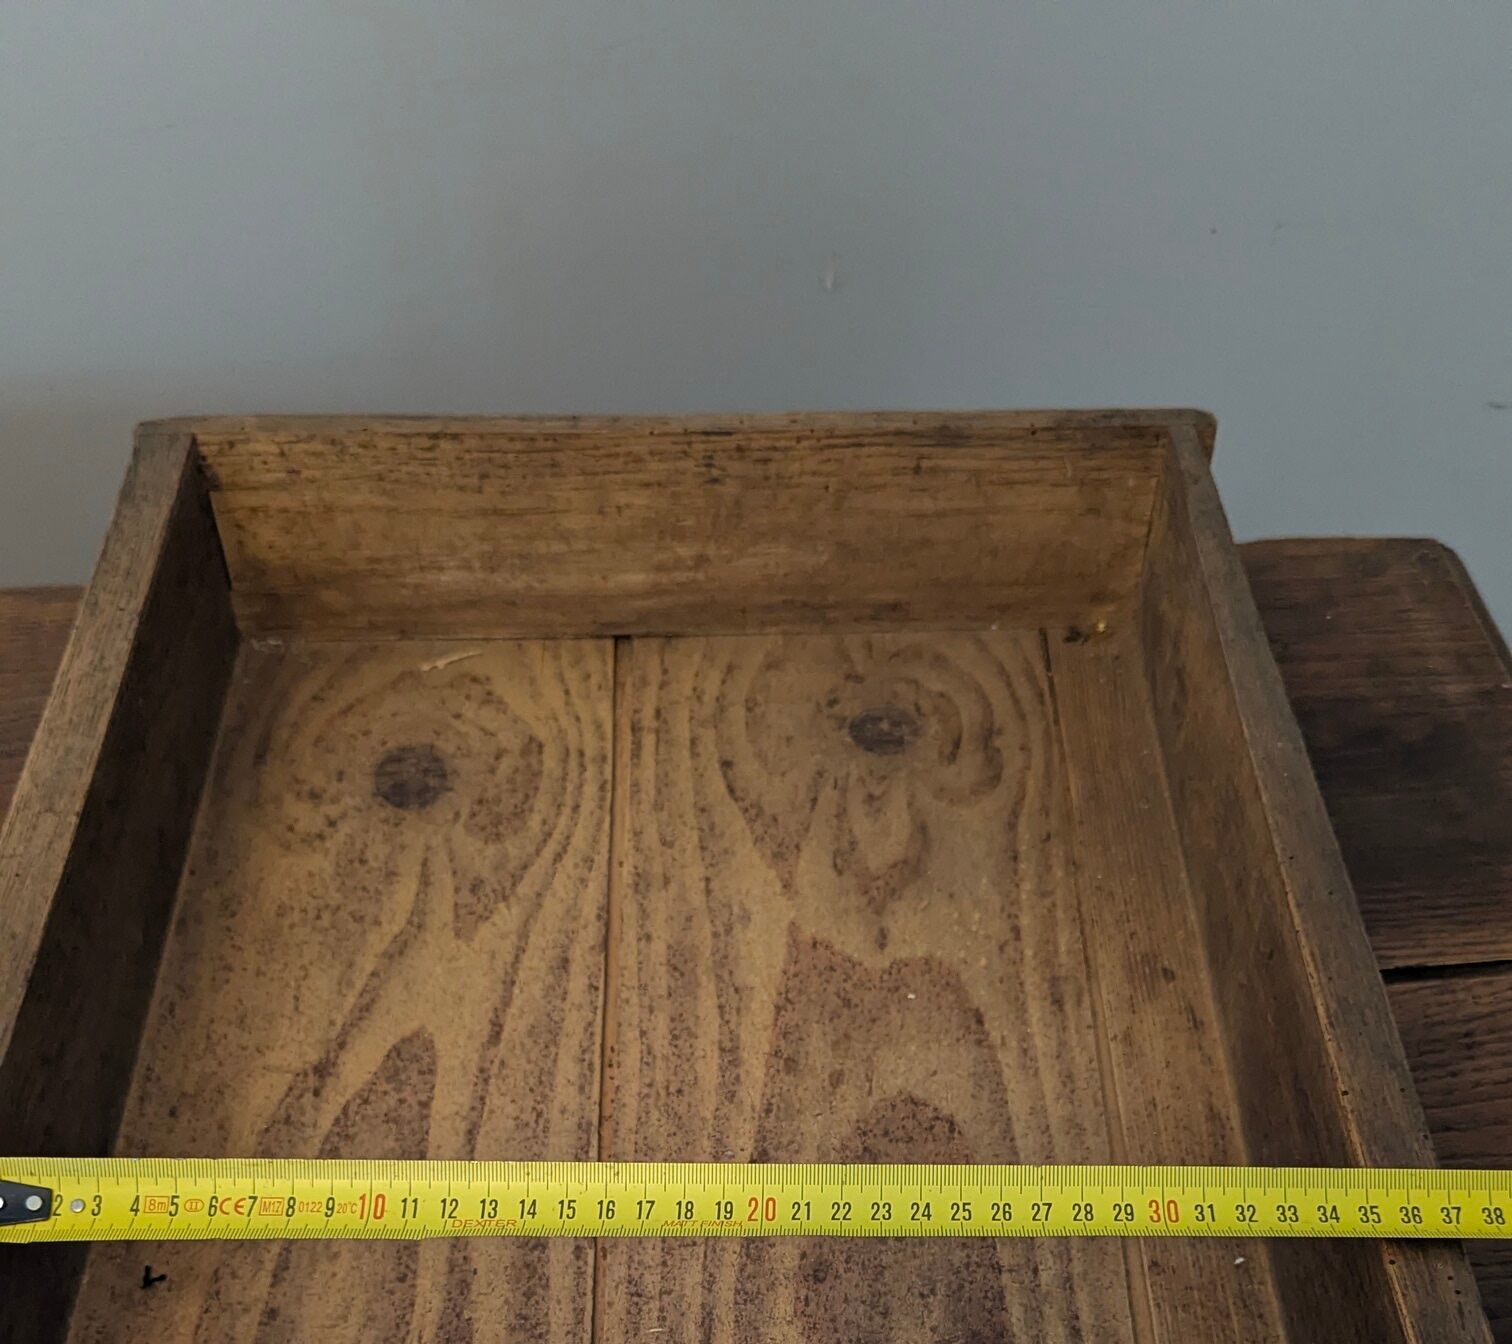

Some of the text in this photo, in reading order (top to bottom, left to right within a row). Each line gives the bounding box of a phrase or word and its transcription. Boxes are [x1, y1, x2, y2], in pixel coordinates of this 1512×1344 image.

[91, 1195, 103, 1217] 3
[130, 1195, 140, 1216] 4
[169, 1195, 180, 1217] 5
[208, 1195, 218, 1217] 6
[247, 1196, 258, 1217] 7
[285, 1196, 297, 1217] 8
[324, 1196, 336, 1218] 9
[359, 1193, 386, 1220] 10
[401, 1198, 418, 1219] 11
[440, 1198, 459, 1219] 12
[480, 1199, 498, 1219] 13
[519, 1199, 537, 1219] 14
[558, 1200, 576, 1219] 15
[597, 1200, 616, 1219] 16
[636, 1200, 655, 1220] 17
[676, 1200, 694, 1220] 18
[715, 1200, 734, 1220] 19
[747, 1197, 776, 1222] 20
[791, 1201, 811, 1221] 21
[831, 1201, 852, 1221] 22
[871, 1202, 892, 1221] 23
[910, 1202, 932, 1221] 24
[950, 1202, 972, 1221] 25
[991, 1202, 1012, 1221] 26
[1031, 1202, 1053, 1221] 27
[1072, 1203, 1094, 1221] 28
[1113, 1203, 1135, 1222] 29
[1148, 1199, 1179, 1223] 30
[1194, 1203, 1216, 1222] 31
[1235, 1204, 1259, 1223] 32
[1276, 1204, 1299, 1224] 33
[1317, 1205, 1341, 1224] 34
[1358, 1205, 1382, 1224] 35
[1399, 1206, 1423, 1225] 36
[1440, 1206, 1462, 1225] 37
[1481, 1206, 1506, 1225] 38
[451, 1219, 517, 1228] DEXTER
[663, 1219, 744, 1228] MATT FINISH
